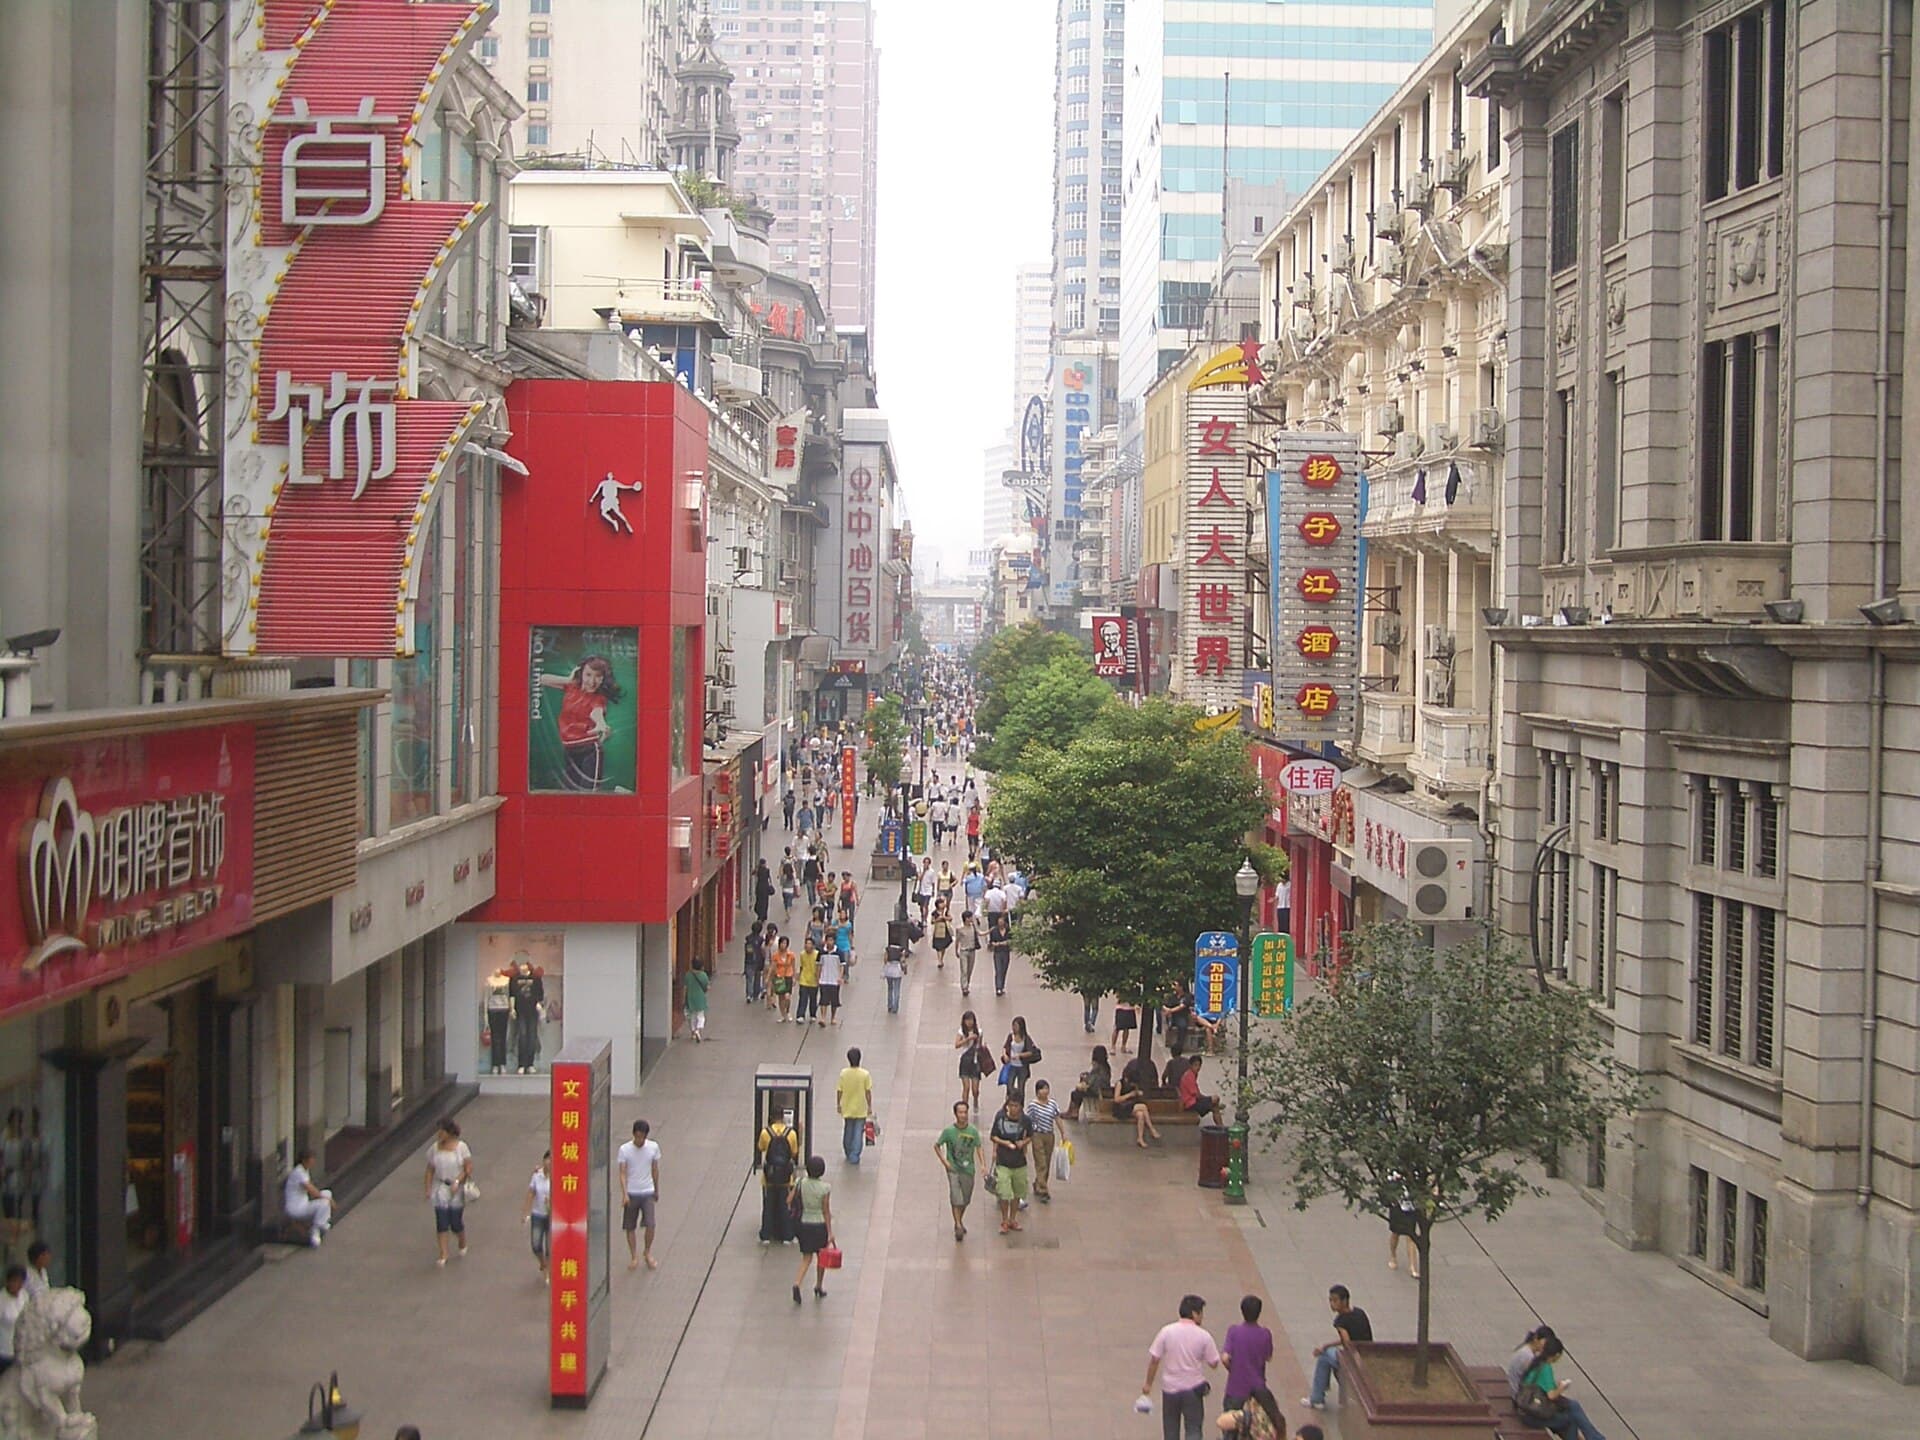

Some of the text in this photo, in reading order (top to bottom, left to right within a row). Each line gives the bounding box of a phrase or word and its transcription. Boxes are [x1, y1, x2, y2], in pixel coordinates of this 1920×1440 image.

[269, 97, 398, 500] 首饰
[775, 424, 797, 468] 客房
[1004, 475, 1048, 487] Kappa
[1193, 415, 1237, 676] 女人大世界
[1301, 459, 1337, 711] 扬子江酒店
[531, 658, 544, 720] Limited
[1098, 665, 1124, 675] KFC
[1287, 766, 1335, 790] 住宿
[98, 791, 225, 902] 明牌首饰
[1209, 963, 1224, 1012] 为中国加油
[560, 1080, 580, 1371] 文明城市 携手共建
